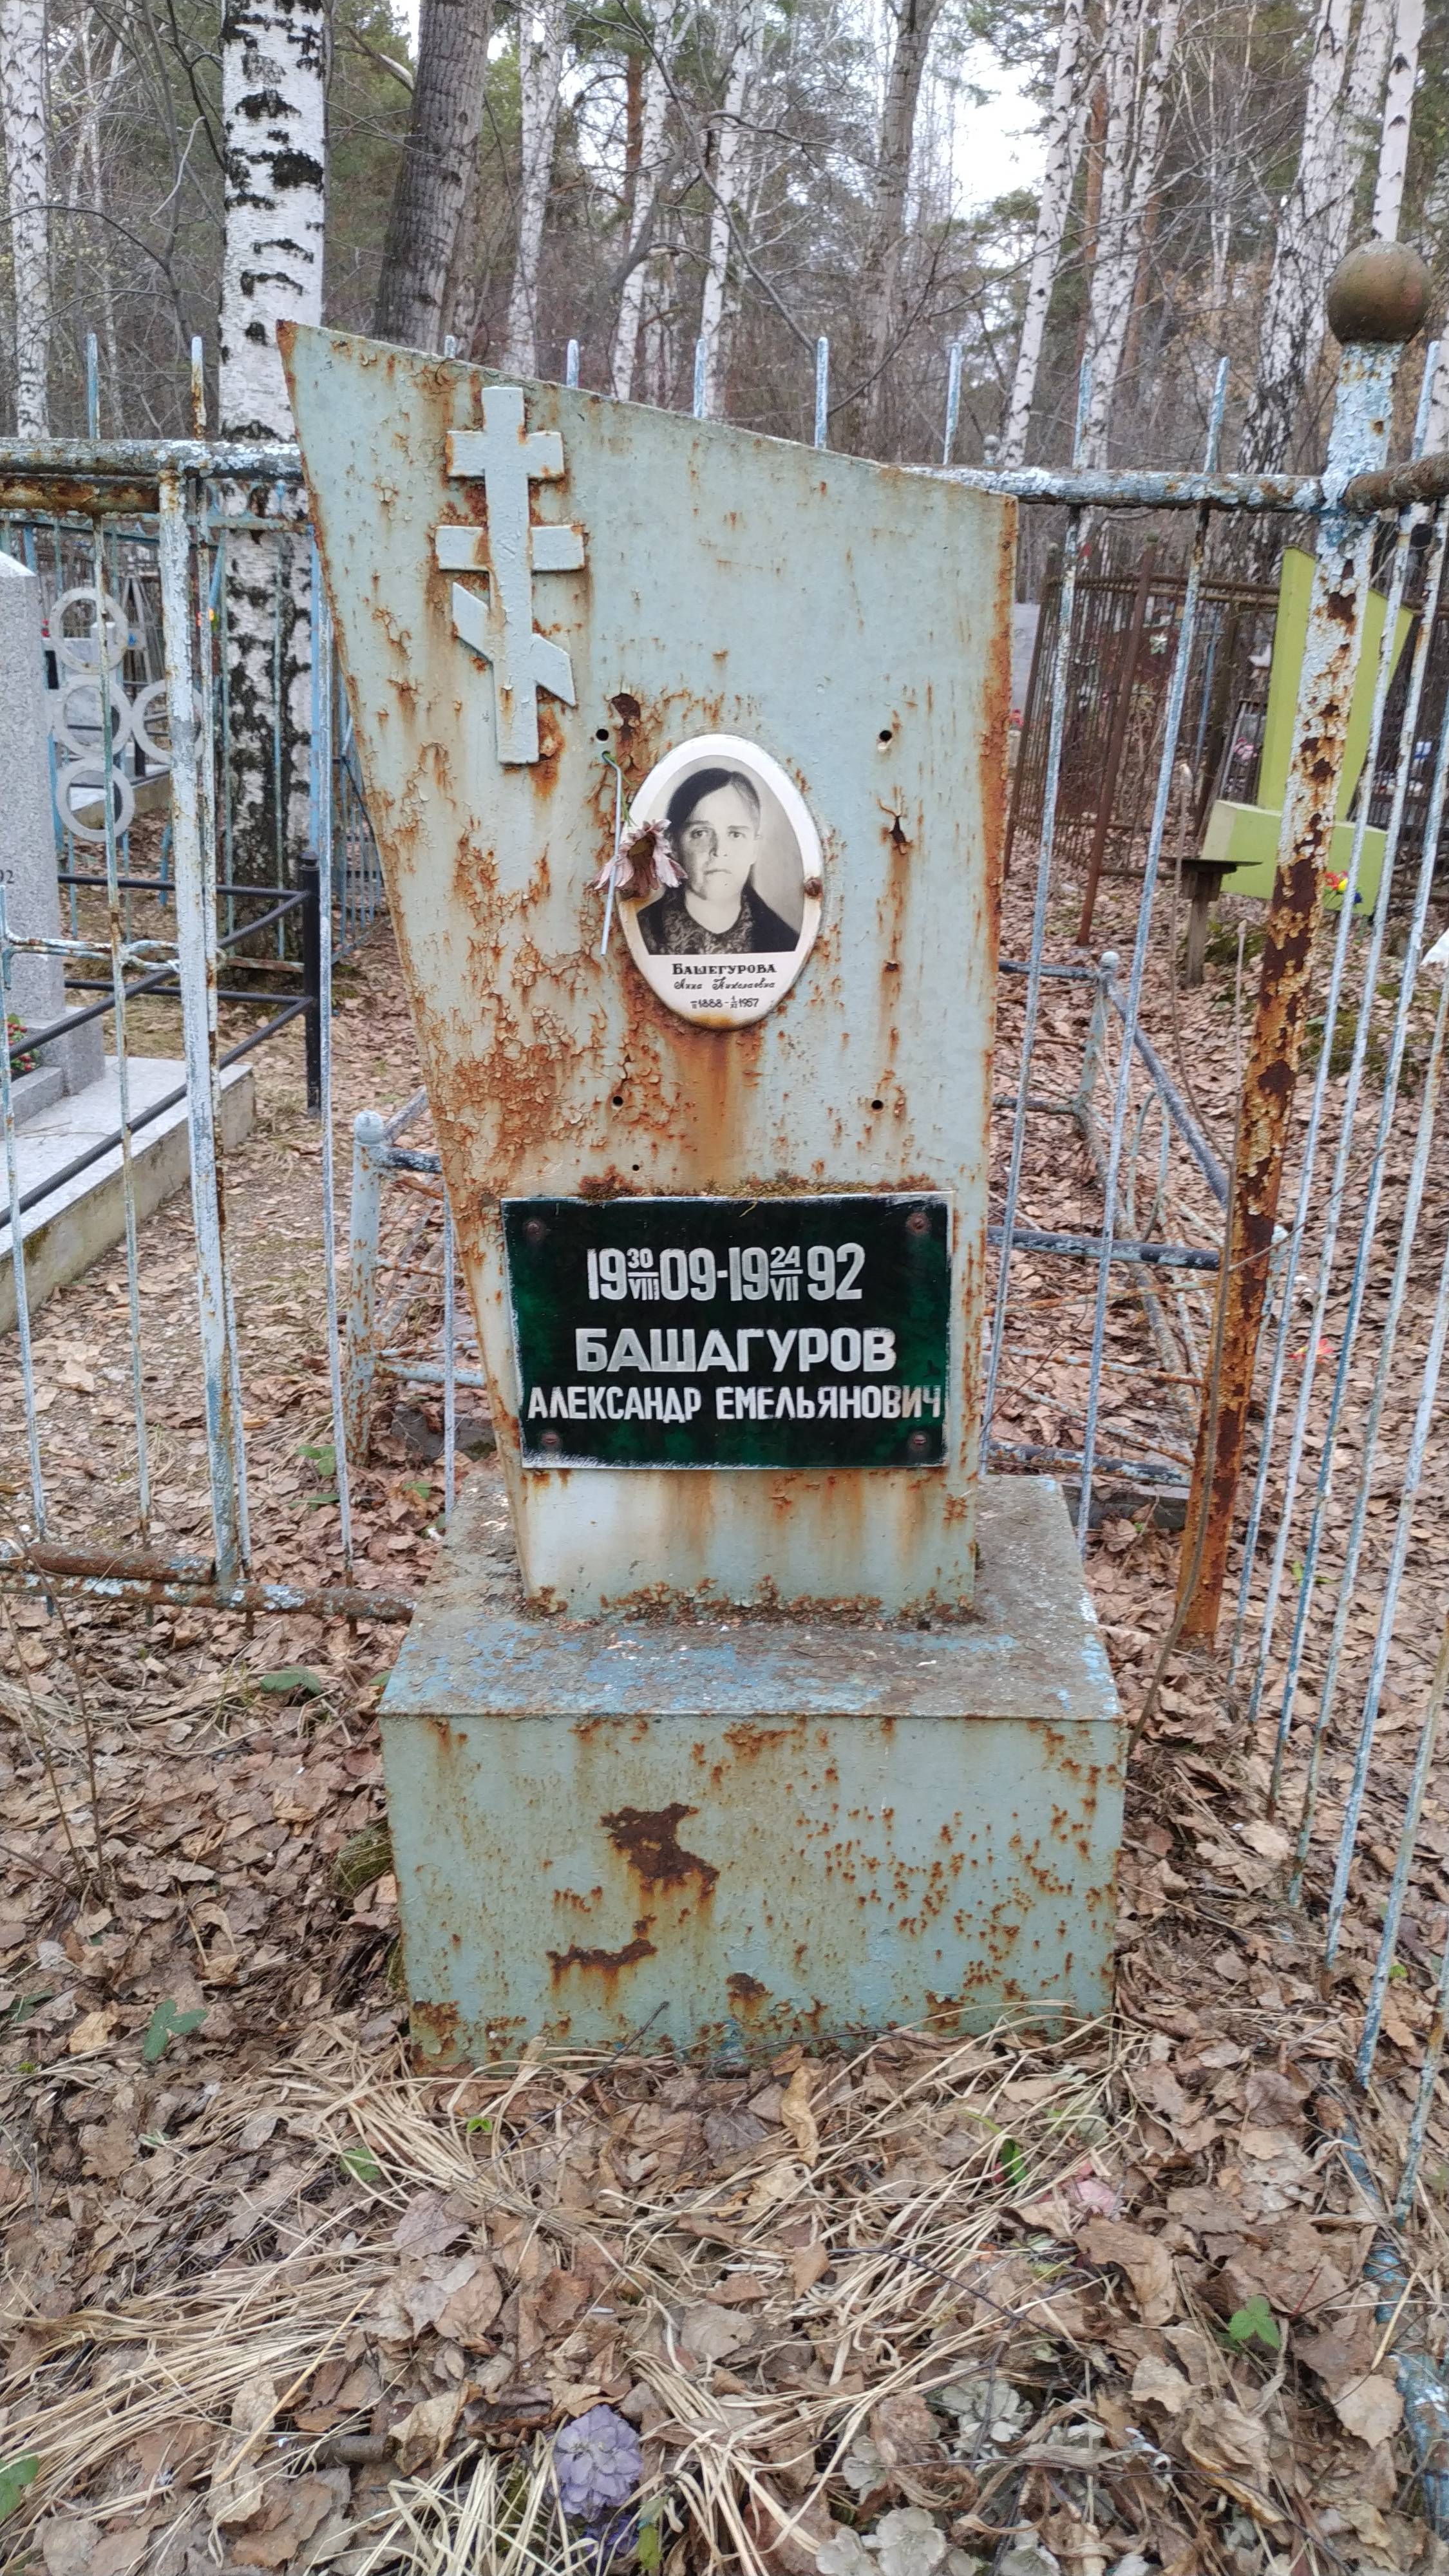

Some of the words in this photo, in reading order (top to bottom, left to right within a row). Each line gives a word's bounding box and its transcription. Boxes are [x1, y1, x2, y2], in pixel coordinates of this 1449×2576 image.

[575, 1327, 896, 1372] БАШАГУРОВ
[528, 1385, 702, 1423] АЛЕКСАНДР
[715, 1385, 940, 1420] ЕМЕЛЬЯНОВИЧ
